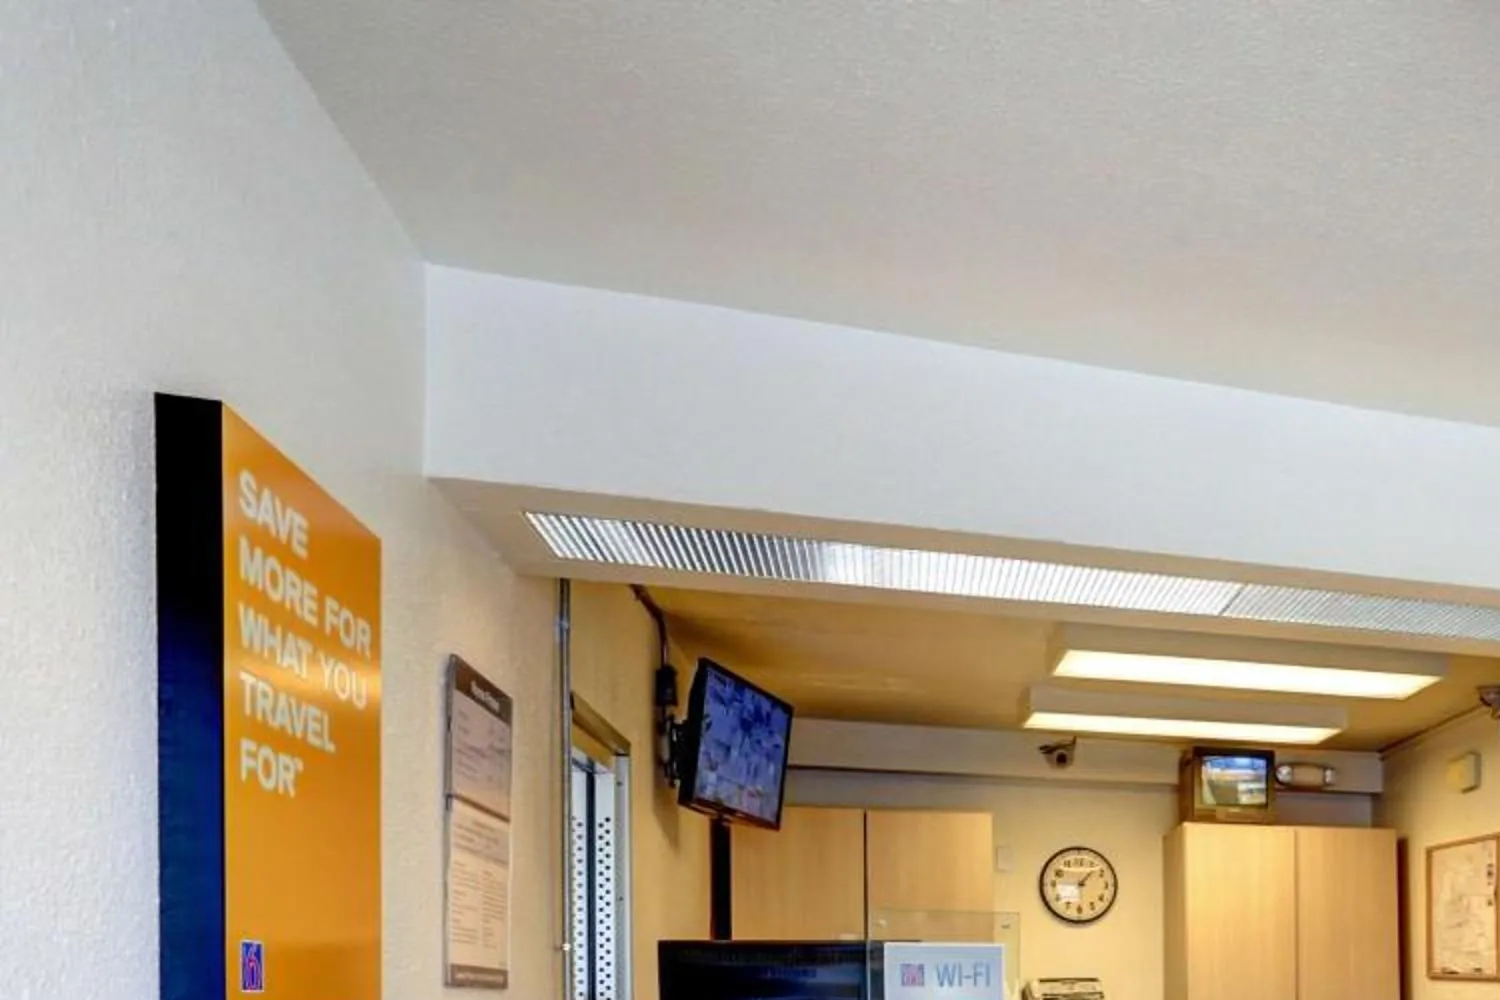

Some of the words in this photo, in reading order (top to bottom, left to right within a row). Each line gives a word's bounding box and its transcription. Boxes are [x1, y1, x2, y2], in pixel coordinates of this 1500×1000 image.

[239, 469, 309, 560] SAVE
[239, 534, 319, 628] MORE
[324, 595, 373, 659] FOR
[238, 601, 314, 680] WHAT
[319, 651, 368, 711] YOU
[239, 670, 337, 753] TRAVEL
[936, 961, 991, 988] WI-FI
